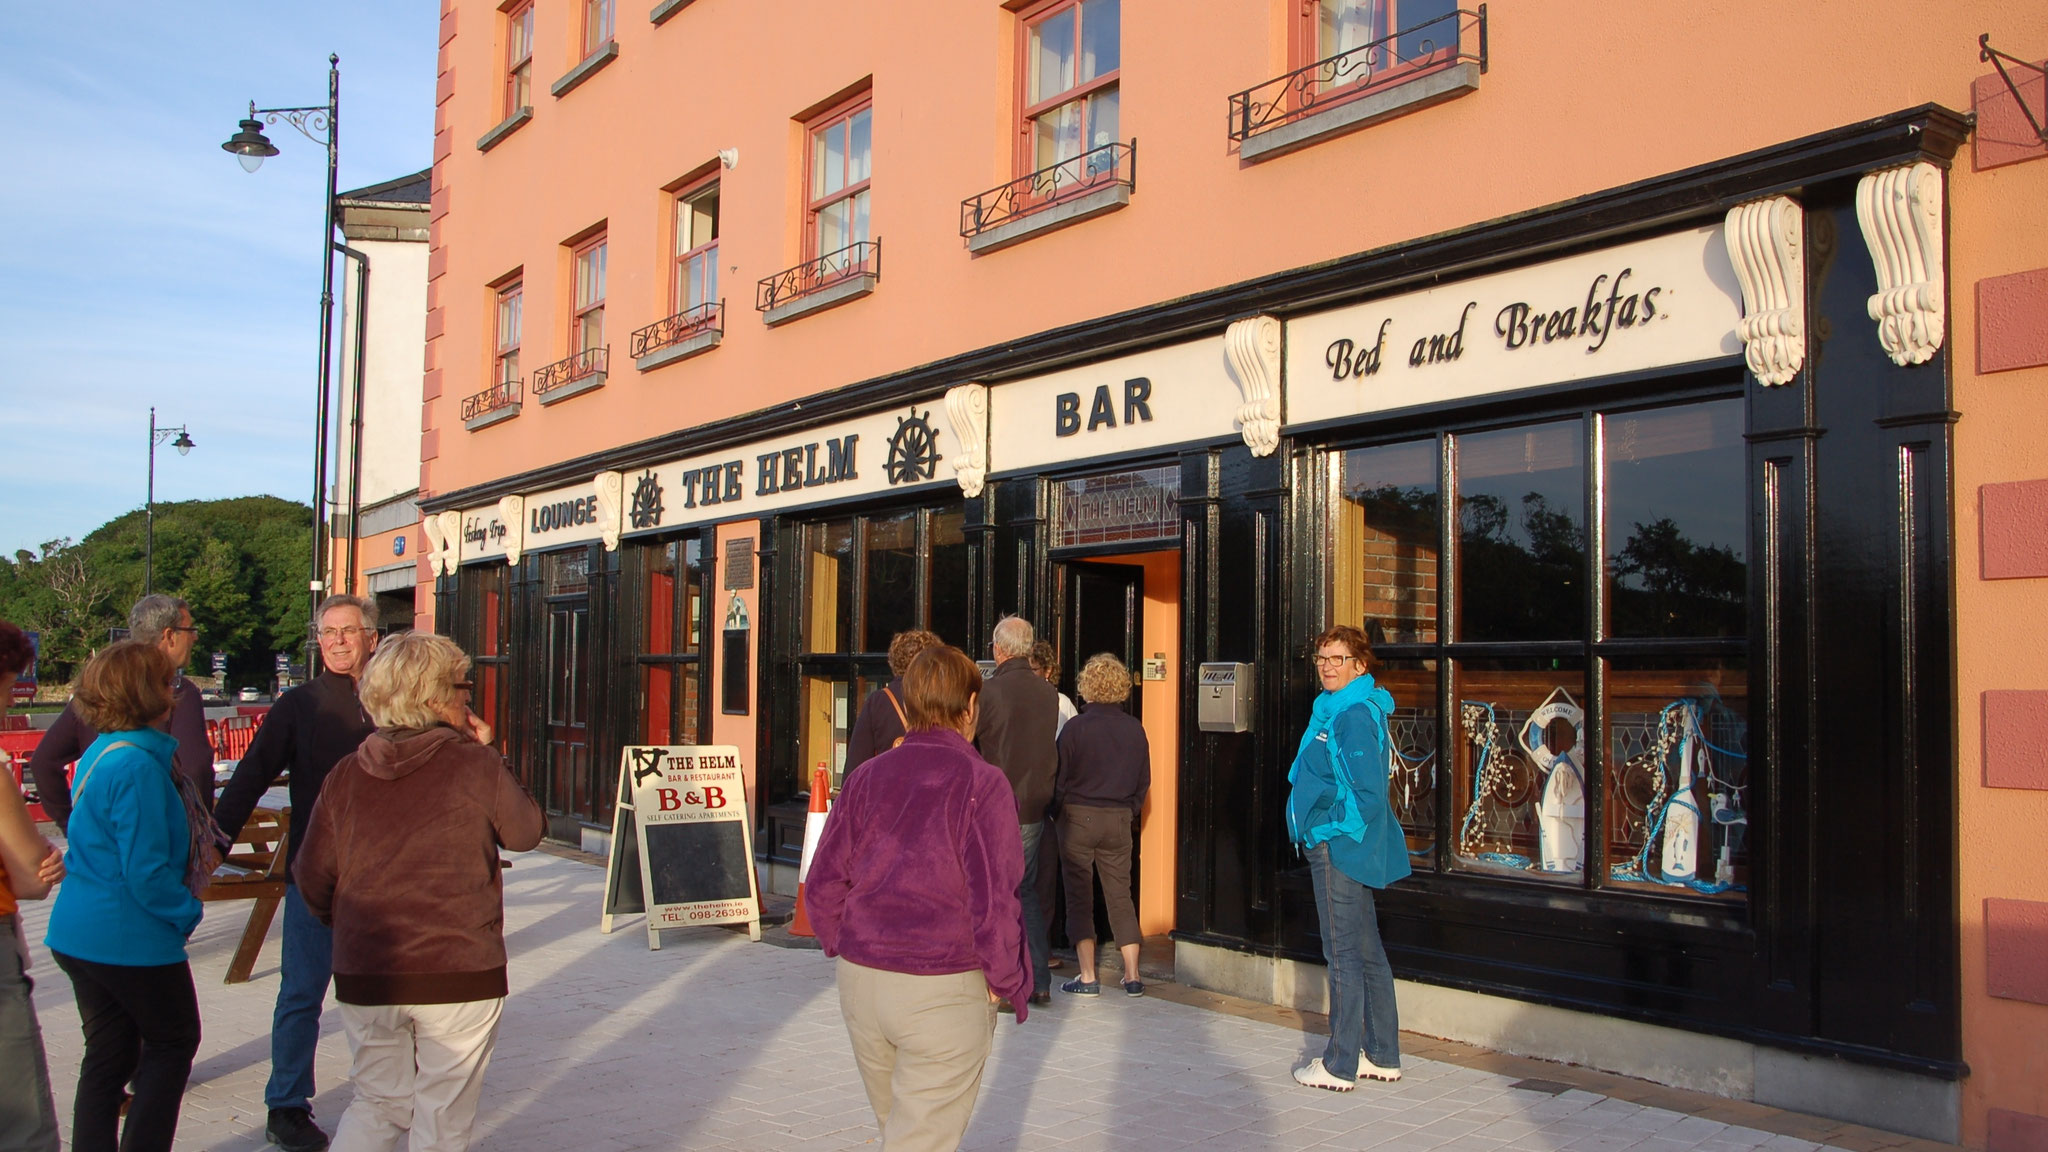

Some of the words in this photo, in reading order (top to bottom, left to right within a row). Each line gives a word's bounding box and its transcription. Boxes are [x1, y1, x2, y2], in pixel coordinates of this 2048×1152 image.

[1325, 318, 1392, 380] Bed
[1409, 301, 1477, 367] and
[1495, 267, 1661, 353] Breakfas
[1056, 377, 1153, 437] BAR
[683, 460, 743, 508] THE
[756, 434, 859, 496] HELM
[531, 495, 598, 533] LOUNGE
[1080, 498, 1110, 520] THE
[1117, 494, 1159, 516] HELM
[1541, 706, 1573, 717] WELCOME
[667, 757, 694, 770] THE
[699, 756, 736, 769] HELM
[668, 774, 682, 782] BAR
[691, 773, 735, 782] RESTAURANT
[656, 786, 727, 811] B&B
[647, 814, 661, 822] SELF
[664, 812, 696, 821] CATERING
[698, 810, 740, 819] APARTMENTS
[661, 913, 684, 922] TEL.
[690, 908, 749, 920] 098-26398
[665, 902, 743, 912] www.thehelm.ie
